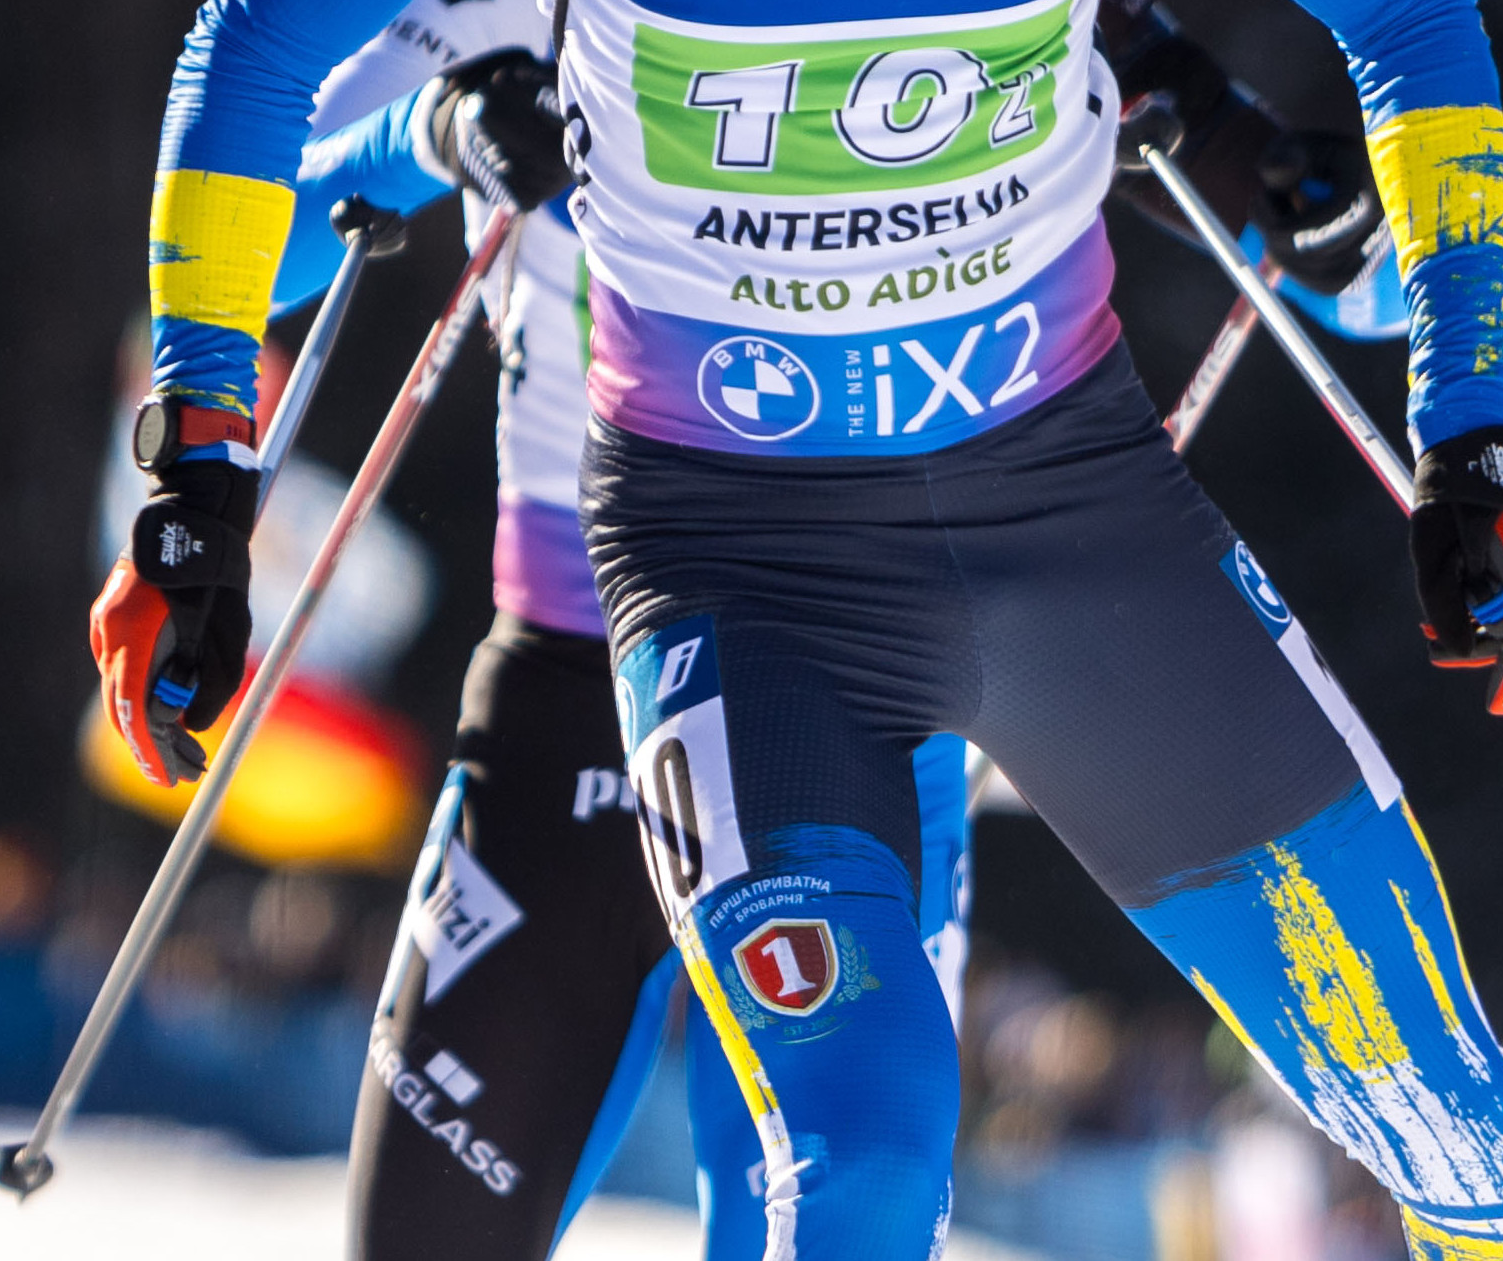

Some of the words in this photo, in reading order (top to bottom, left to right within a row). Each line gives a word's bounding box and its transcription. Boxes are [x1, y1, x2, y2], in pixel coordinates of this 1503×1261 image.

[685, 48, 991, 172] 10
[713, 342, 800, 377] BMW
[845, 349, 863, 395] NEW
[872, 301, 1041, 437] iX2
[848, 403, 865, 437] THE
[709, 887, 752, 929] ПЕРША
[750, 875, 831, 894] ПРИВАТНА
[734, 893, 804, 923] БРОВАРНЯ
[761, 936, 816, 997] 1
